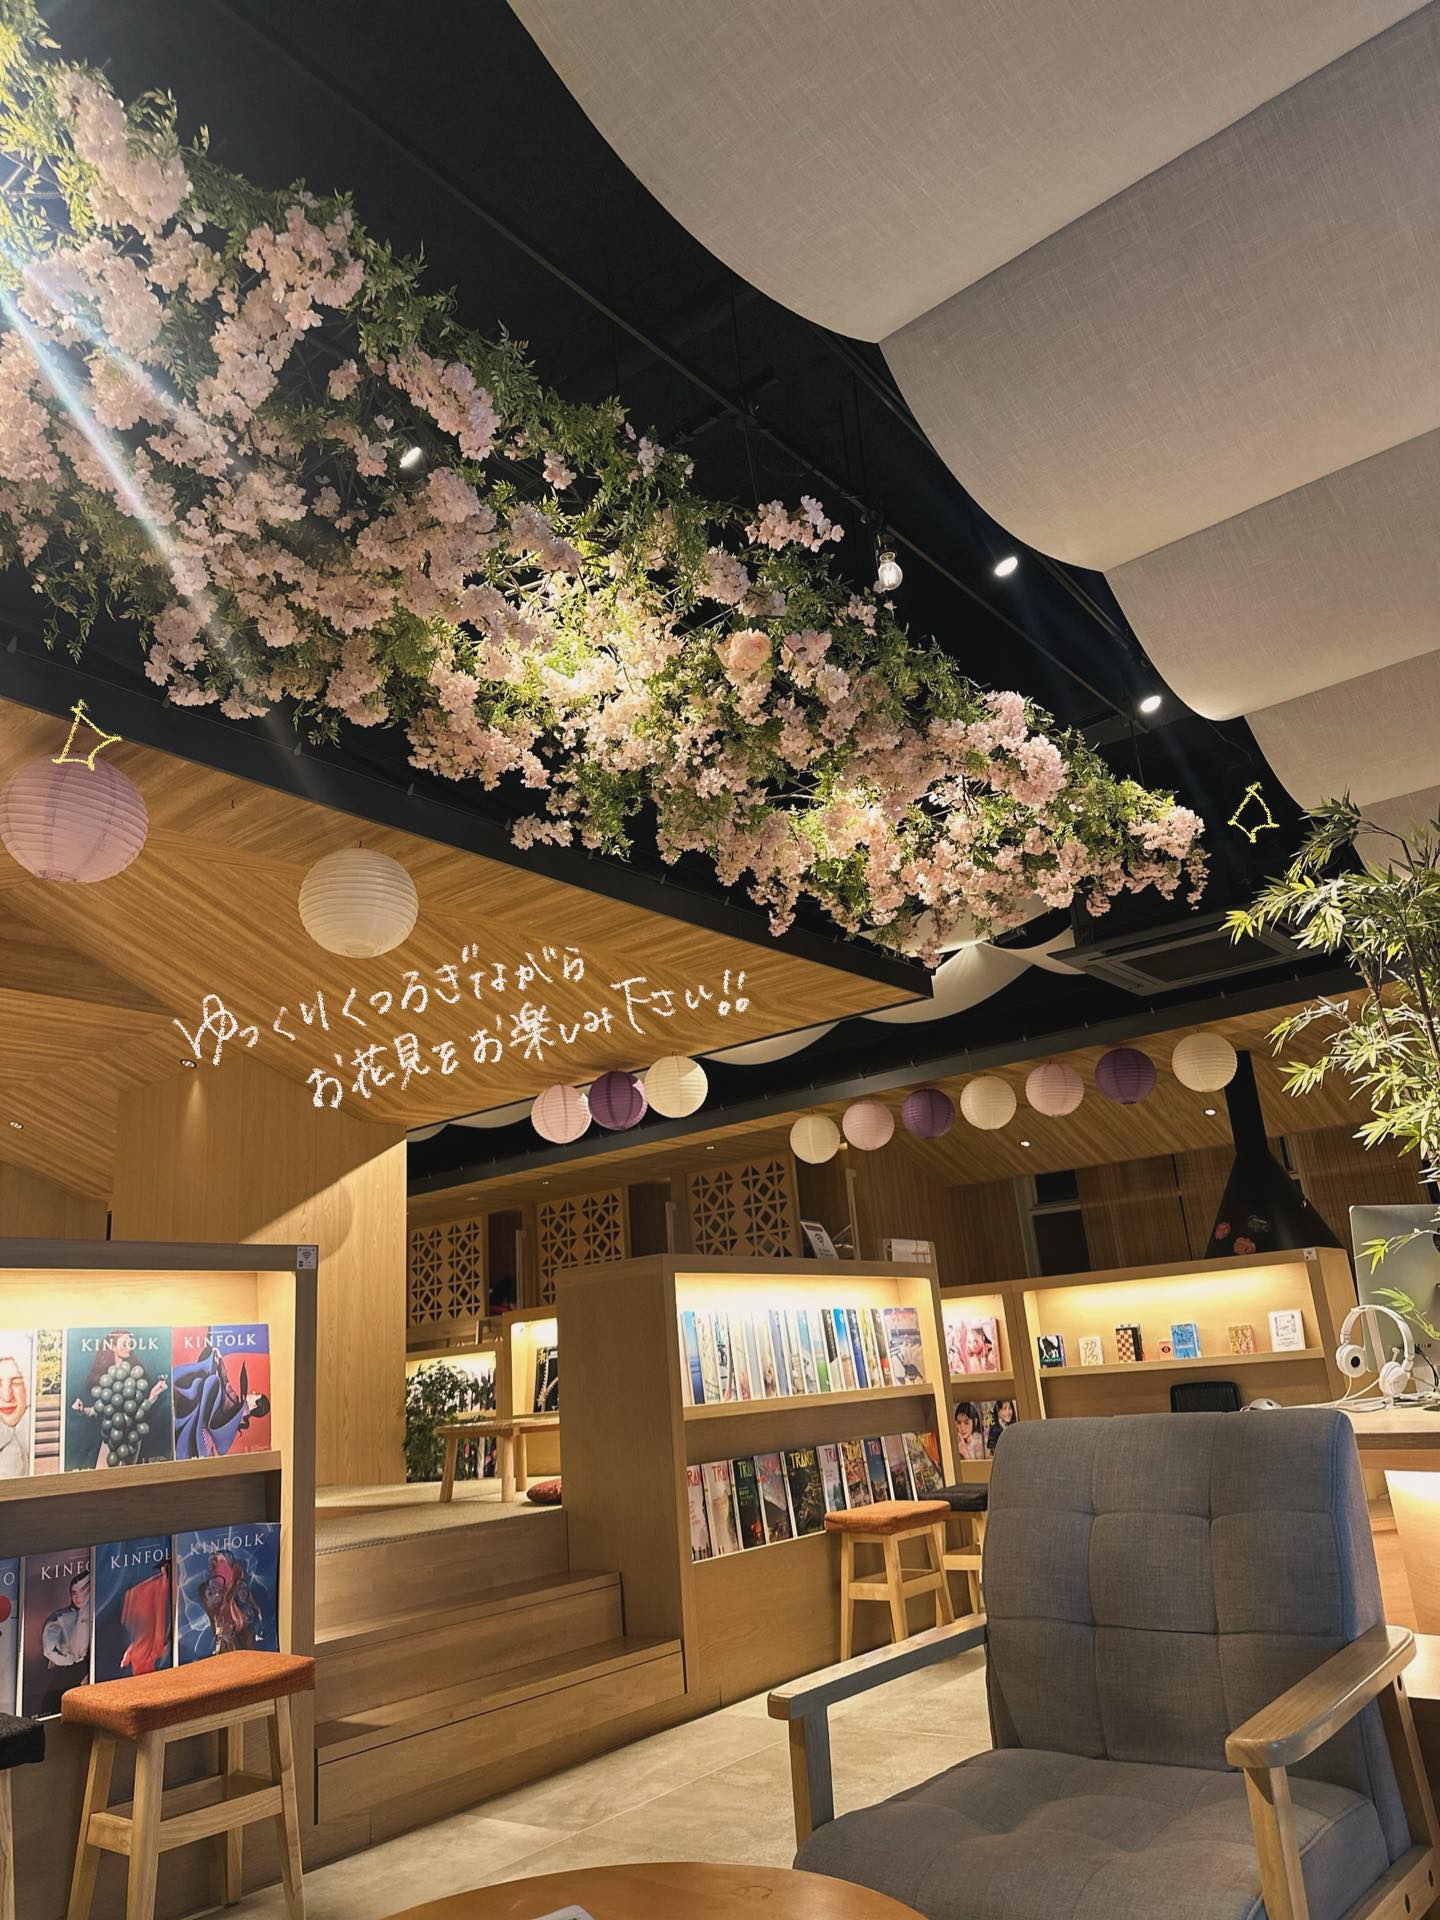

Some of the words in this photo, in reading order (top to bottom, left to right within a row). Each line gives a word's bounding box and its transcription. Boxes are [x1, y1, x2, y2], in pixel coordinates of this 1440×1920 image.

[81, 1336, 159, 1352] KINFOLK
[184, 1333, 257, 1349] KINFOLK
[190, 1533, 265, 1556] KINFOLK
